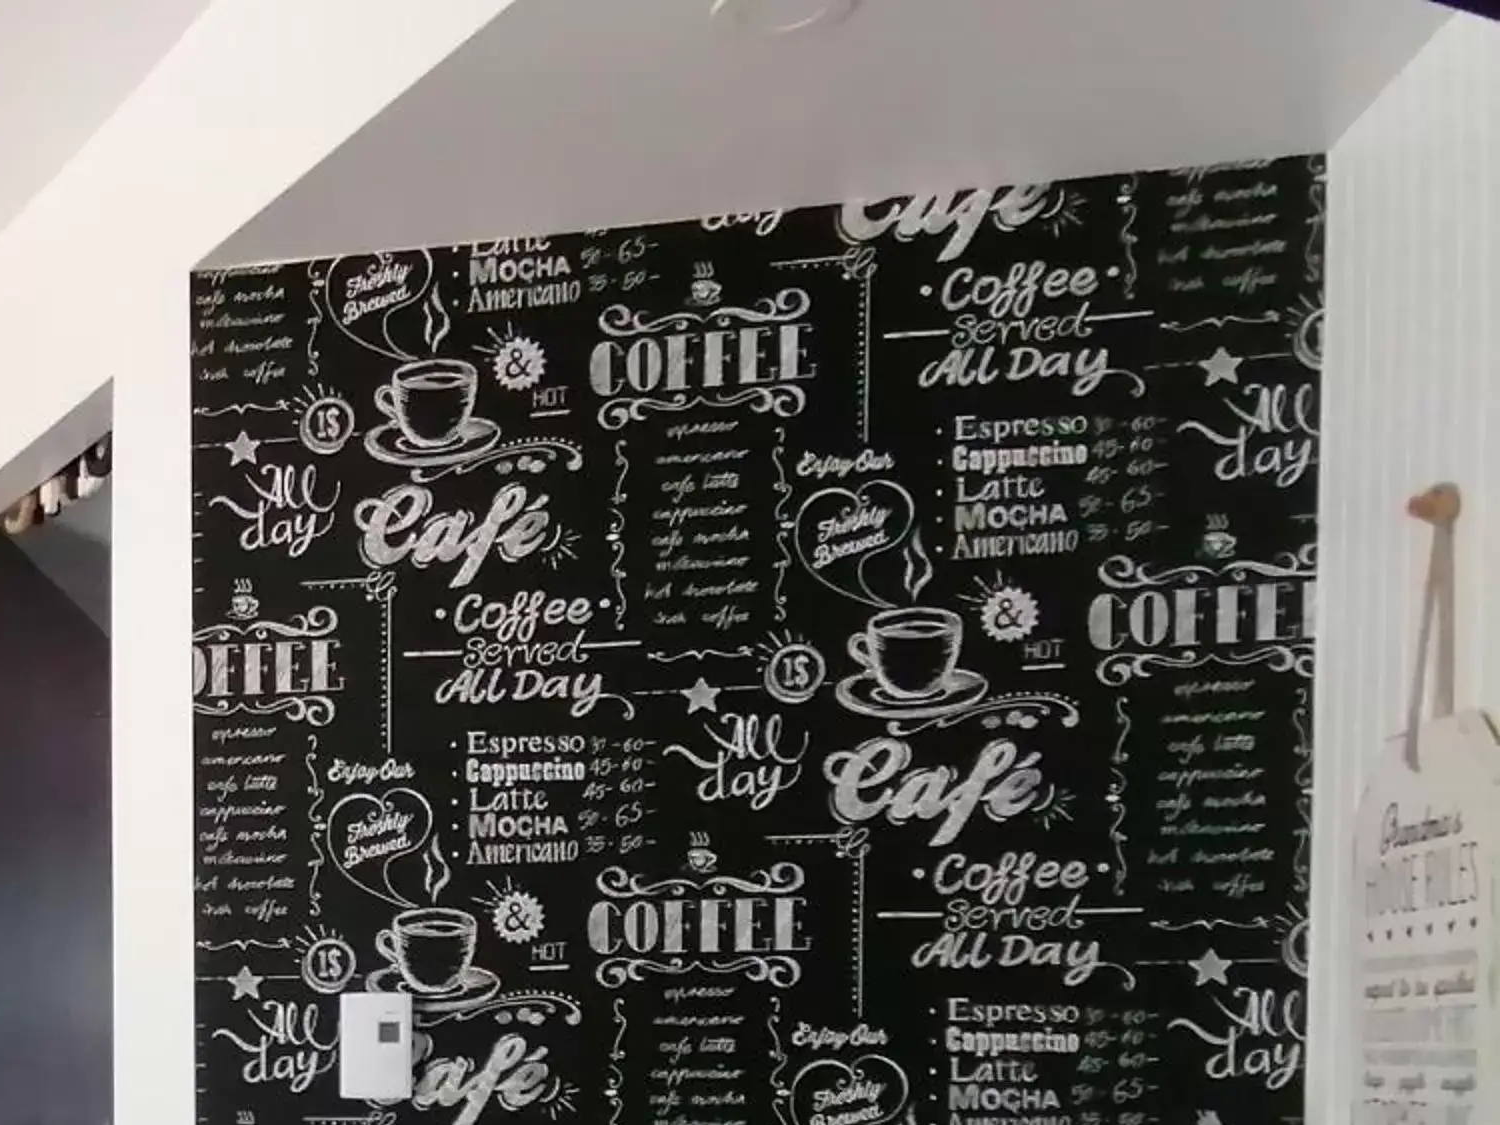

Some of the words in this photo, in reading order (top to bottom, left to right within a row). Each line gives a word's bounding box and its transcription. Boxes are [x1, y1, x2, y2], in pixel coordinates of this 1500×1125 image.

[346, 262, 414, 298] Freshly
[468, 280, 581, 312] Americano
[941, 260, 1098, 317] Coffee
[342, 285, 412, 326] Brewed
[952, 302, 1092, 348] Served
[589, 325, 817, 397] COFFEE
[919, 346, 998, 388] All
[1006, 347, 1110, 396] Day
[533, 386, 569, 408] HOT
[1222, 383, 1320, 436] All
[955, 415, 1088, 444] Espresso
[952, 440, 1088, 476] Cappuccino
[1176, 421, 1311, 487] day
[245, 463, 340, 512] All
[957, 476, 1046, 502] Latte
[209, 496, 334, 557] day
[354, 483, 550, 588] Café
[955, 504, 1069, 533] MOCHA
[951, 529, 1080, 559] Americano
[454, 590, 592, 642] Coffee
[463, 630, 589, 668] Served
[1025, 640, 1063, 660] HOT
[435, 667, 506, 704] All
[512, 668, 603, 717] Day
[467, 731, 586, 757] Espresso
[704, 713, 809, 764] All
[327, 758, 379, 784] Enjoy
[465, 756, 586, 787] Cappuccino
[662, 744, 801, 810] day
[470, 787, 549, 812] Latte
[823, 737, 1042, 848] Café
[347, 811, 415, 844] Freshly
[468, 813, 569, 840] MOCHA
[344, 838, 412, 869] Brewed
[466, 839, 580, 865] Americano
[933, 852, 1090, 903] Coffee
[588, 897, 811, 955] COFFEE
[945, 896, 1084, 931] Served
[531, 943, 568, 961] HOT
[911, 932, 990, 970] All
[999, 935, 1101, 985] Day
[247, 1000, 340, 1050] All
[948, 998, 1080, 1028] Espresso
[1211, 987, 1306, 1040] All
[945, 1025, 1080, 1057] Cappuccino
[1167, 1017, 1300, 1090] day
[211, 1028, 336, 1092] day
[950, 1055, 1038, 1082] Latte
[948, 1083, 1061, 1113] MOCHA
